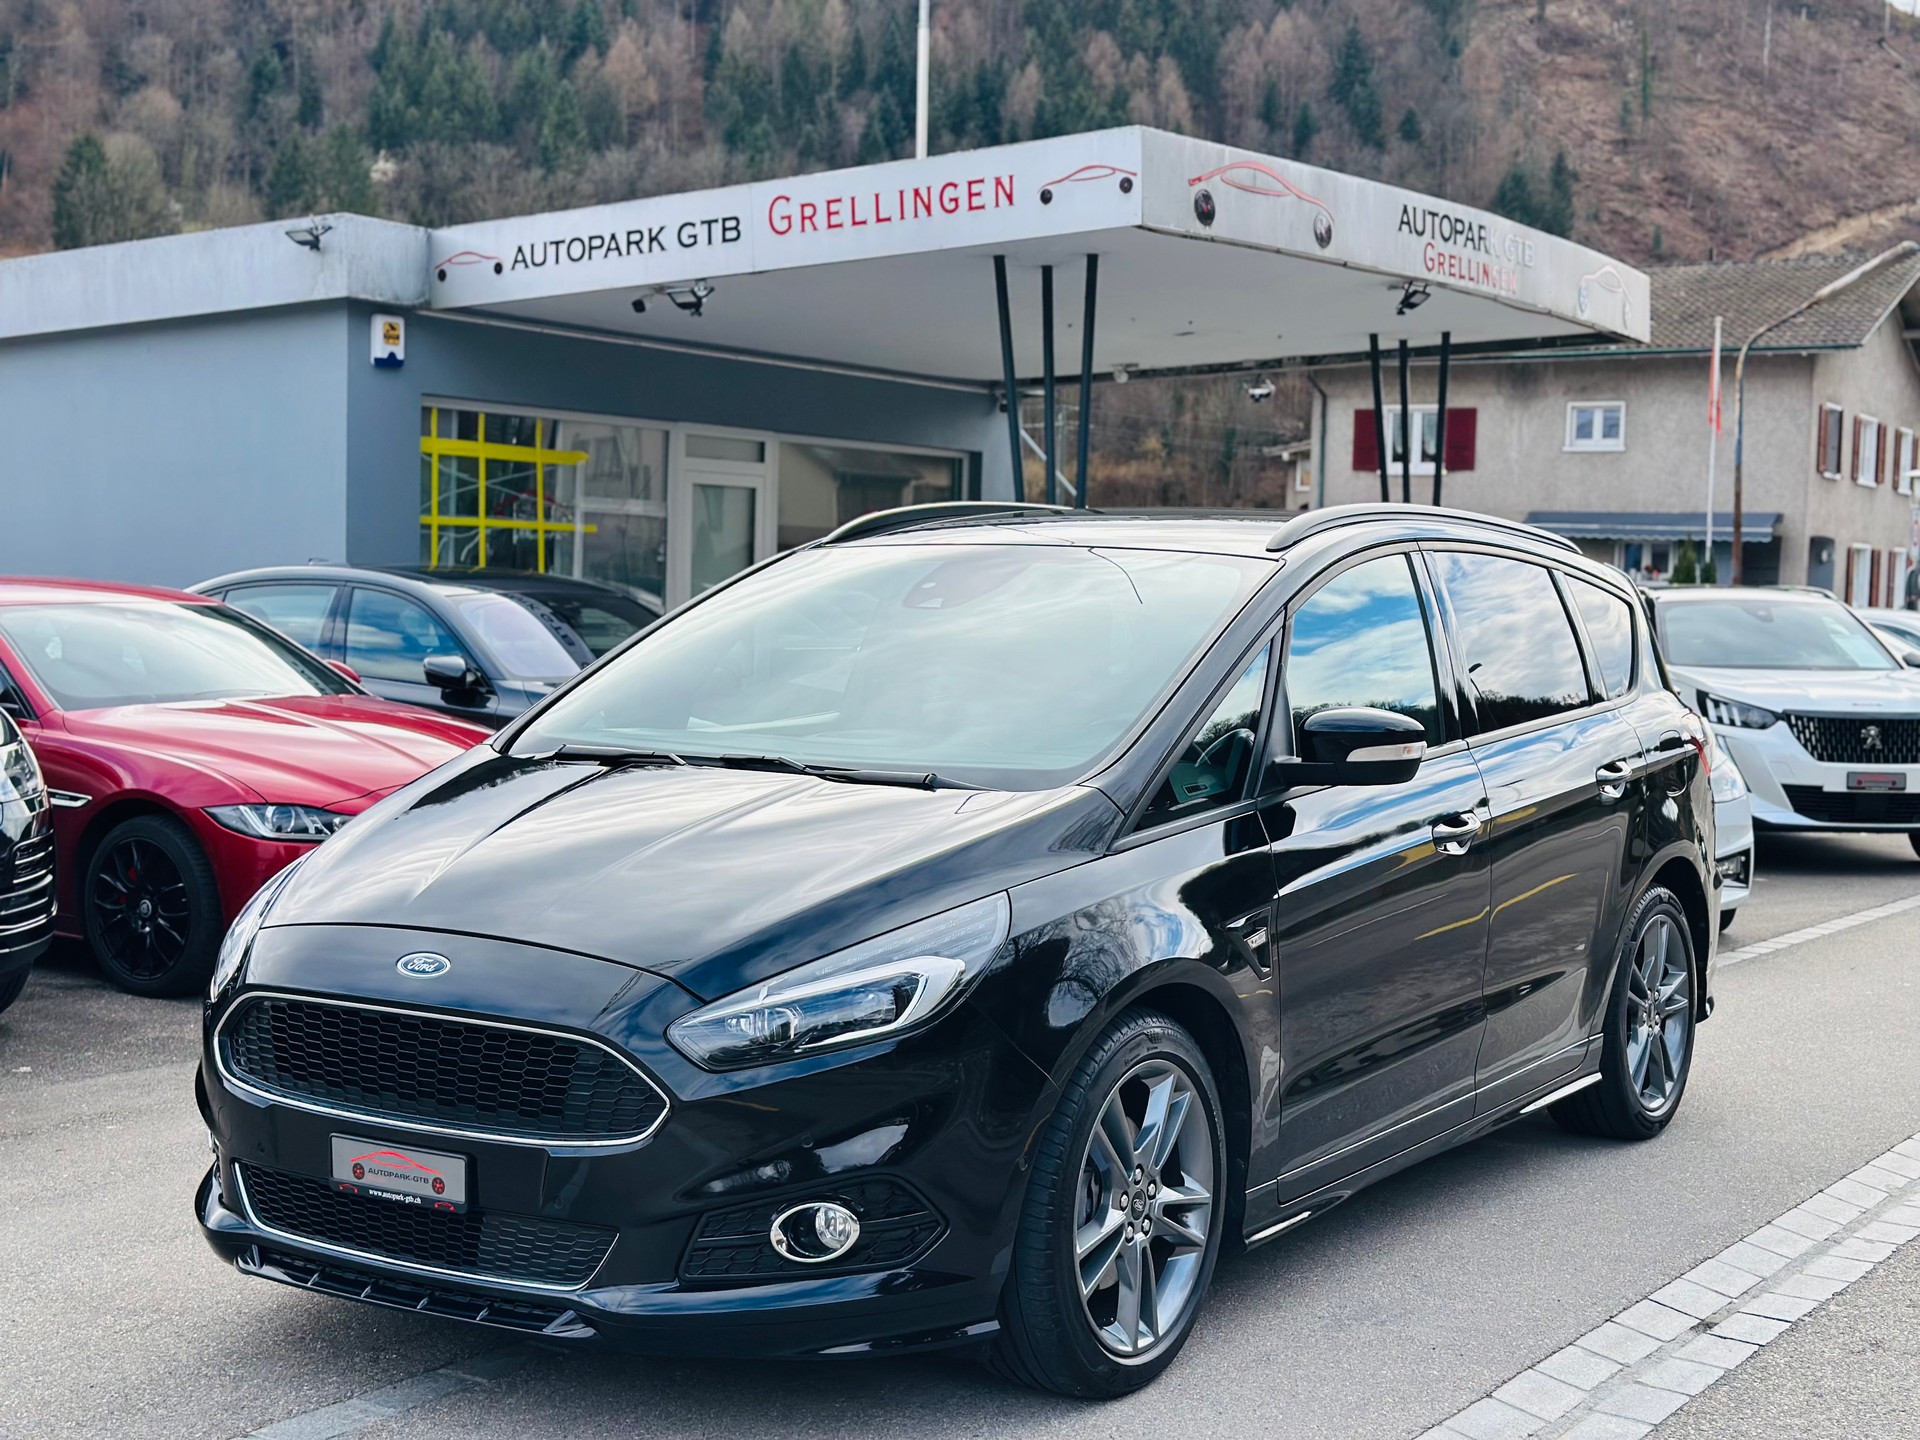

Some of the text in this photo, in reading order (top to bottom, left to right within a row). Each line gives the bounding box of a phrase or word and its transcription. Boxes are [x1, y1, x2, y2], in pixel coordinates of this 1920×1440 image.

[511, 175, 1014, 271] AUTOPARK GTB GRELLINGEN
[1398, 204, 1535, 269] AUTOPARK GTB
[1423, 242, 1517, 295] GRELLINGEN
[407, 957, 439, 972] Ford
[368, 1167, 430, 1185] AUTOPARK-GTB
